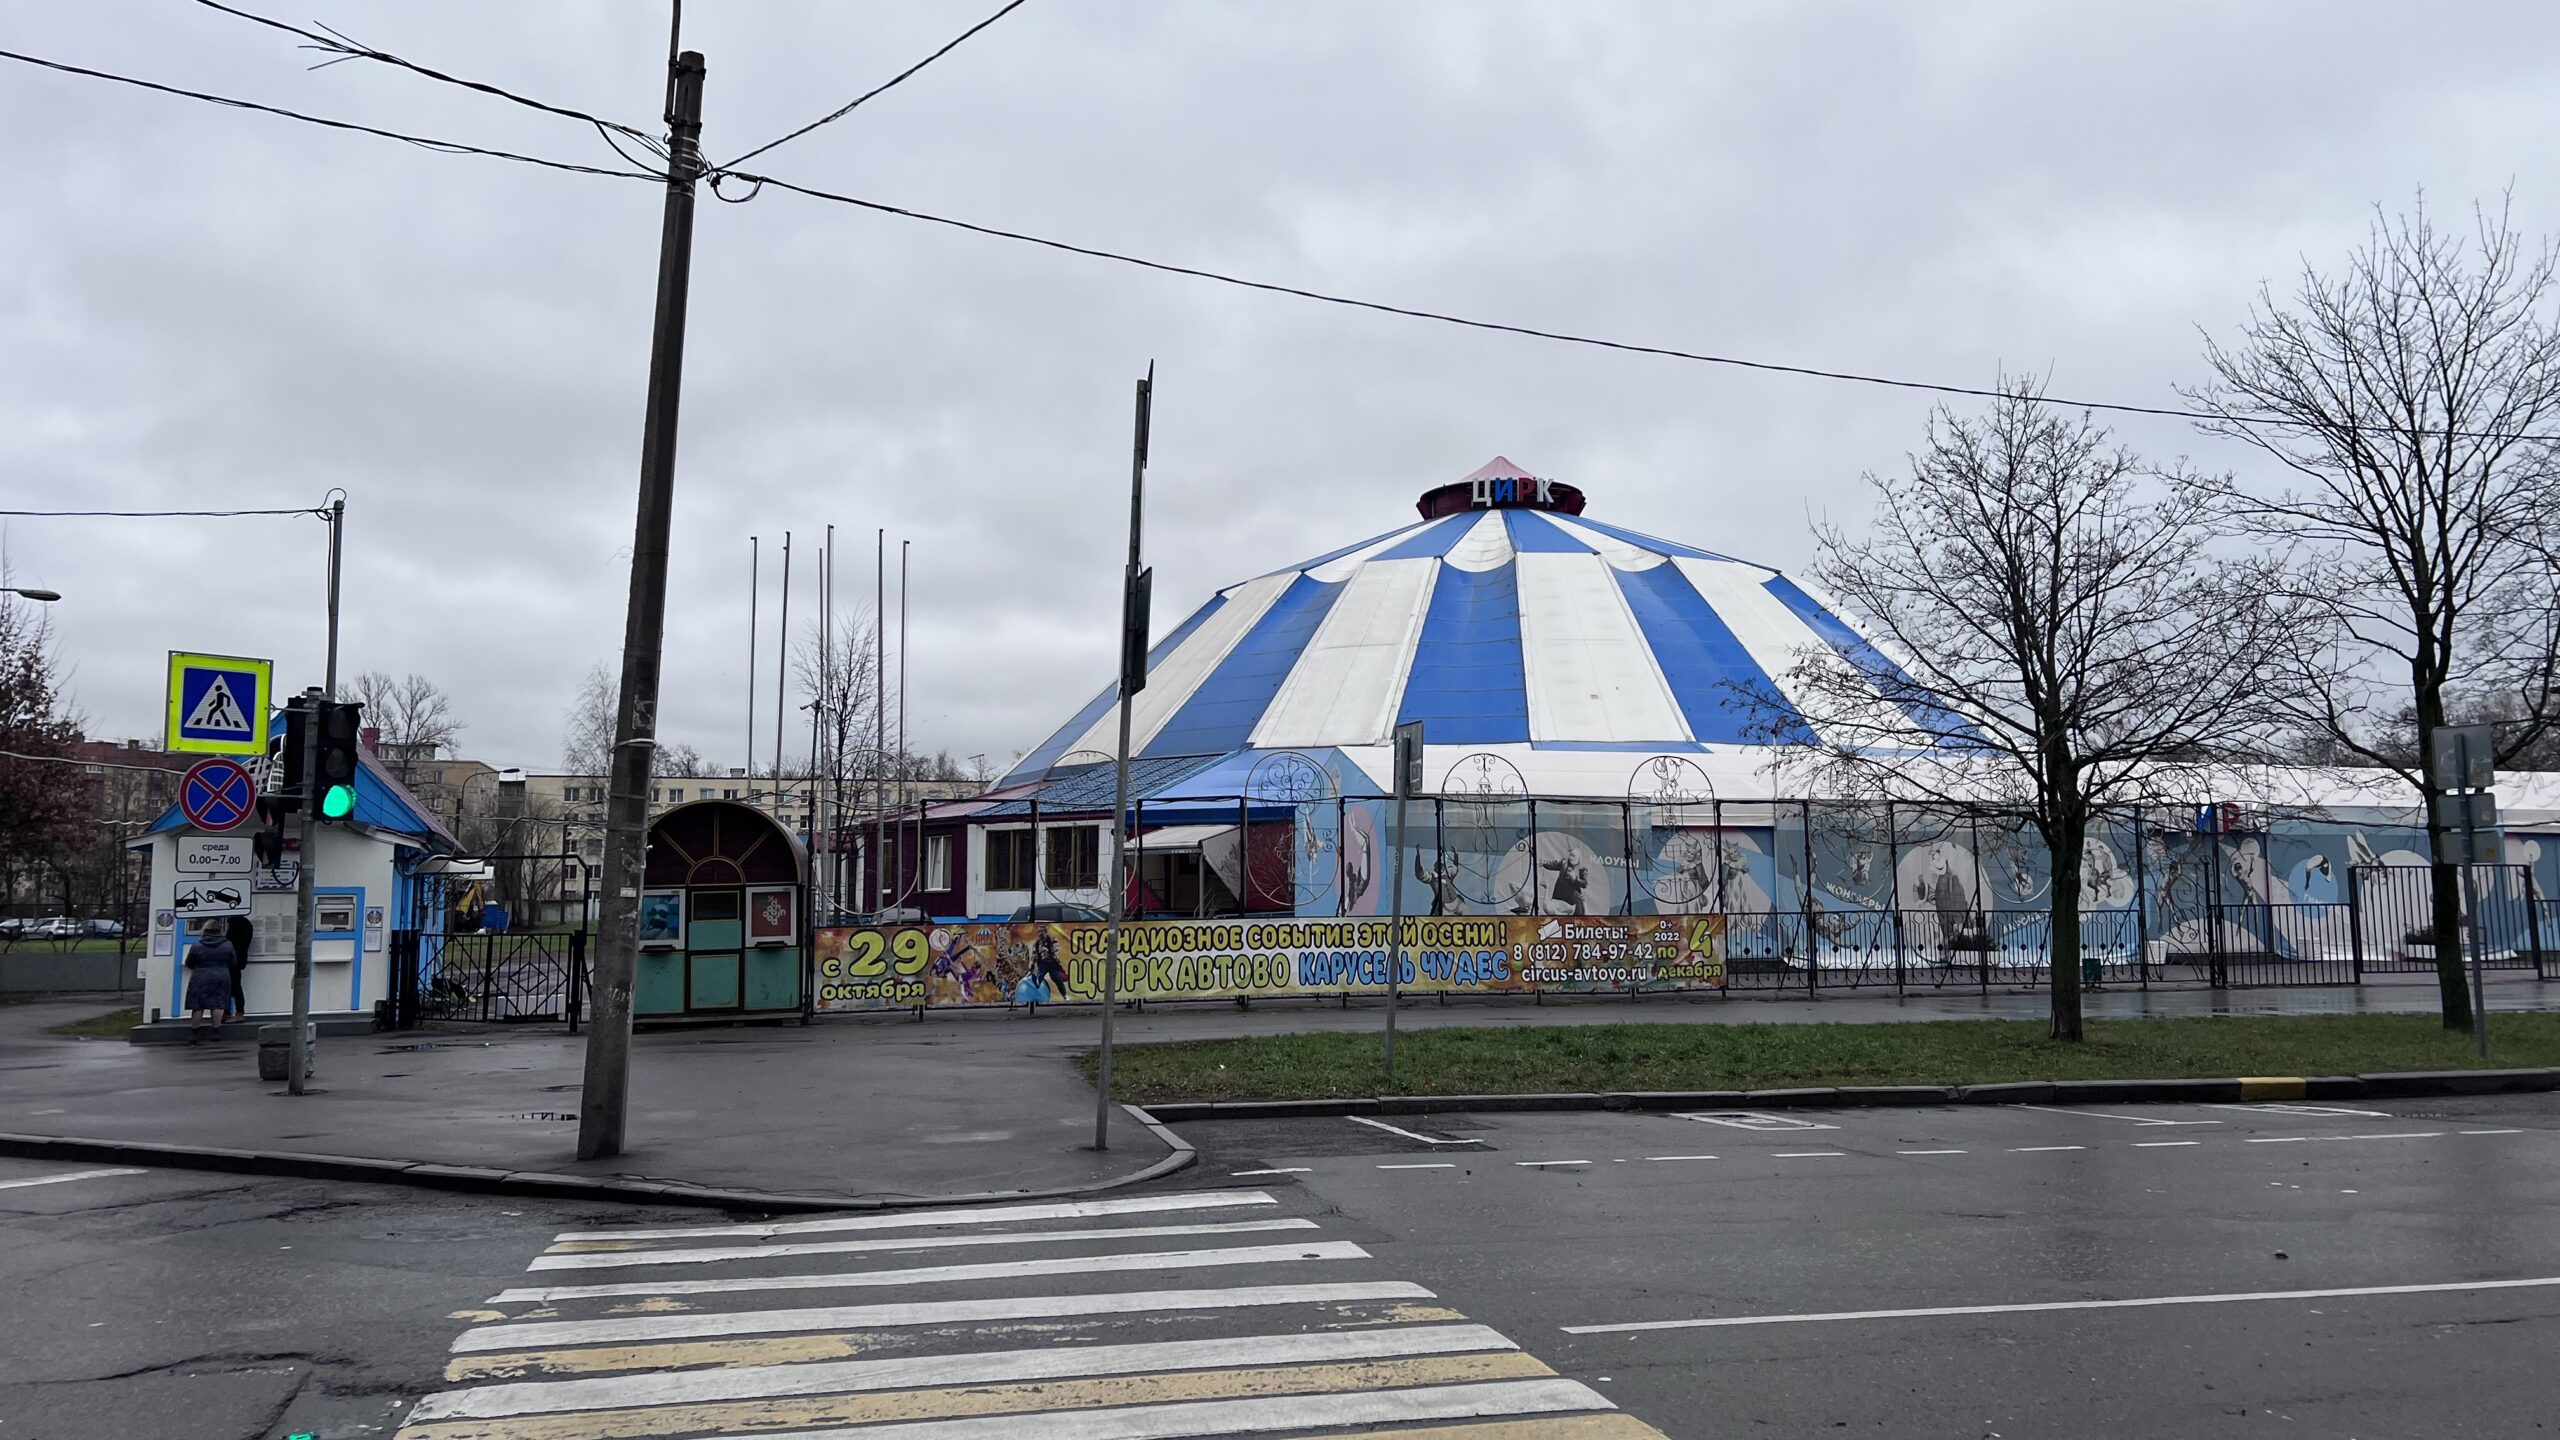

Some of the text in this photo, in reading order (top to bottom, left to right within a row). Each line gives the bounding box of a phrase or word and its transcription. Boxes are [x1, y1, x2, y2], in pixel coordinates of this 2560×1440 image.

[1472, 477, 1554, 507] ЦИРК
[202, 844, 229, 852] среда
[1565, 923, 1628, 941] Билеты:
[1660, 920, 1673, 929] 0+
[1071, 925, 1243, 957] ГРАНДИОЗНОЕ
[1247, 923, 1354, 949] СОБЫТИЕ
[1654, 932, 1680, 942] 2022
[1656, 919, 1712, 960] по 4
[822, 928, 931, 978] с 29
[1513, 943, 1653, 962] 8 (812) 784-97-42
[1420, 950, 1510, 986] ЧУДЕС
[1521, 964, 1647, 982] circus-avtovo.ru
[1657, 961, 1722, 981] декабря
[821, 978, 925, 1002] октября
